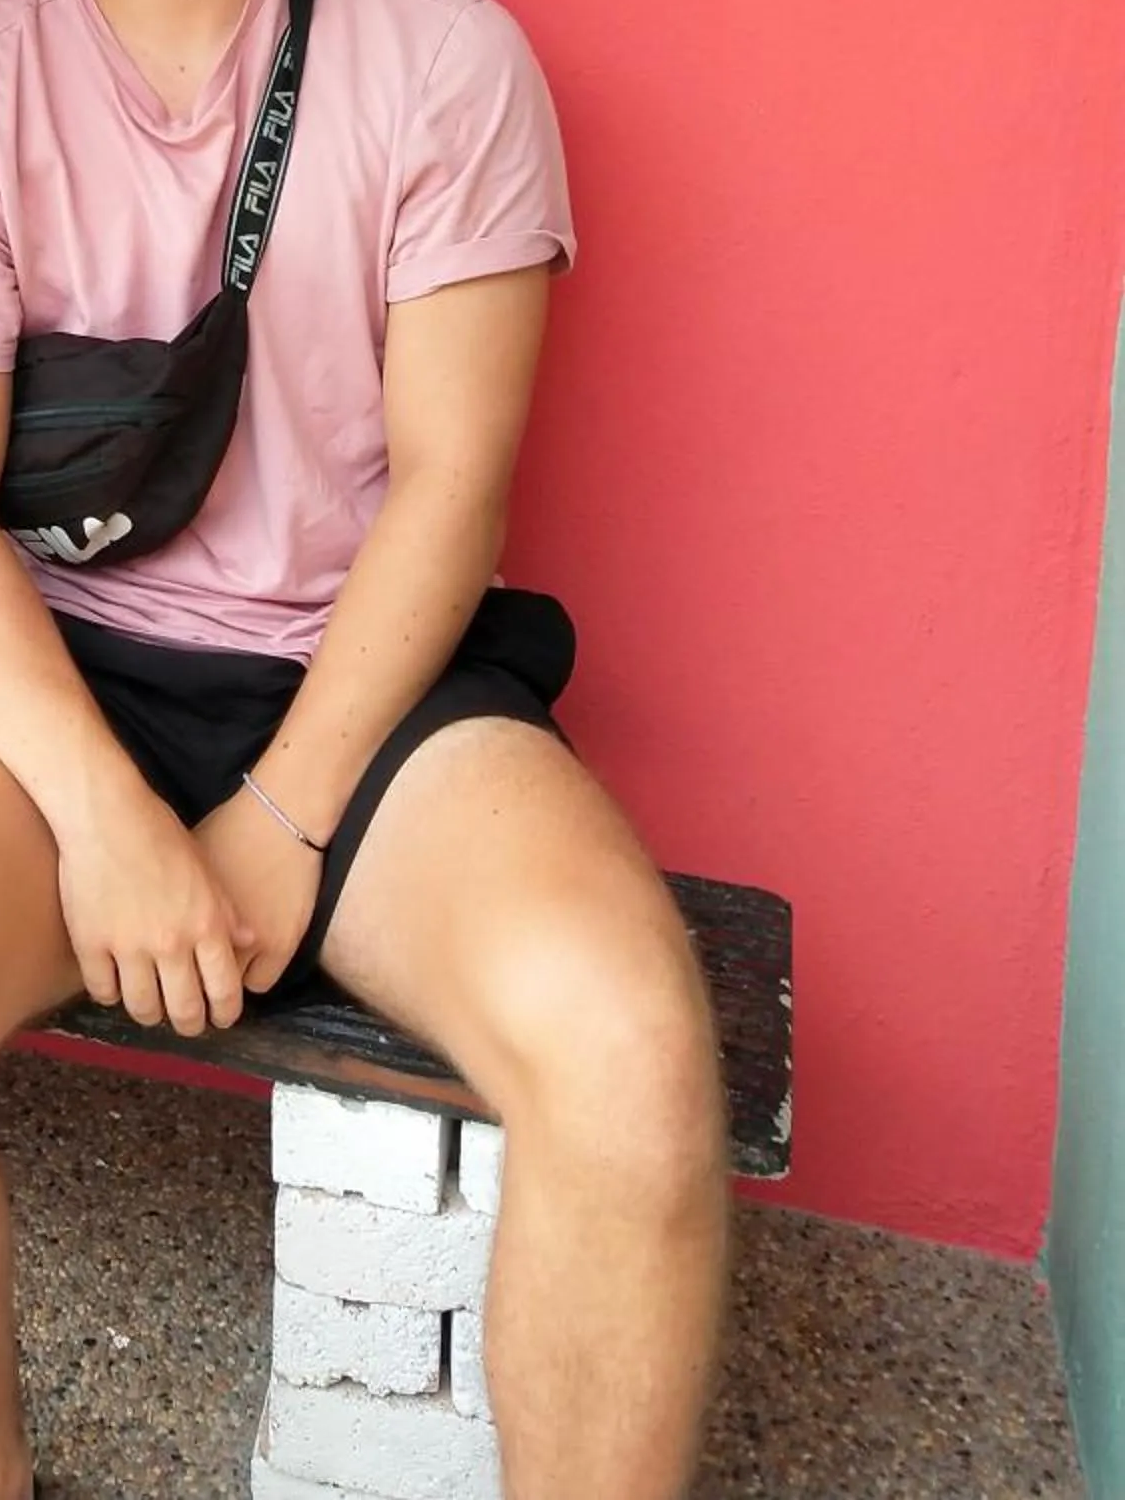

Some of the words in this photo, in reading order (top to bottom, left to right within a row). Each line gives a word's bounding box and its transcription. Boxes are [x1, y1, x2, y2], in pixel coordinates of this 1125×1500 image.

[263, 90, 295, 144] FILA
[244, 160, 278, 216] FILA
[230, 232, 261, 291] FILA
